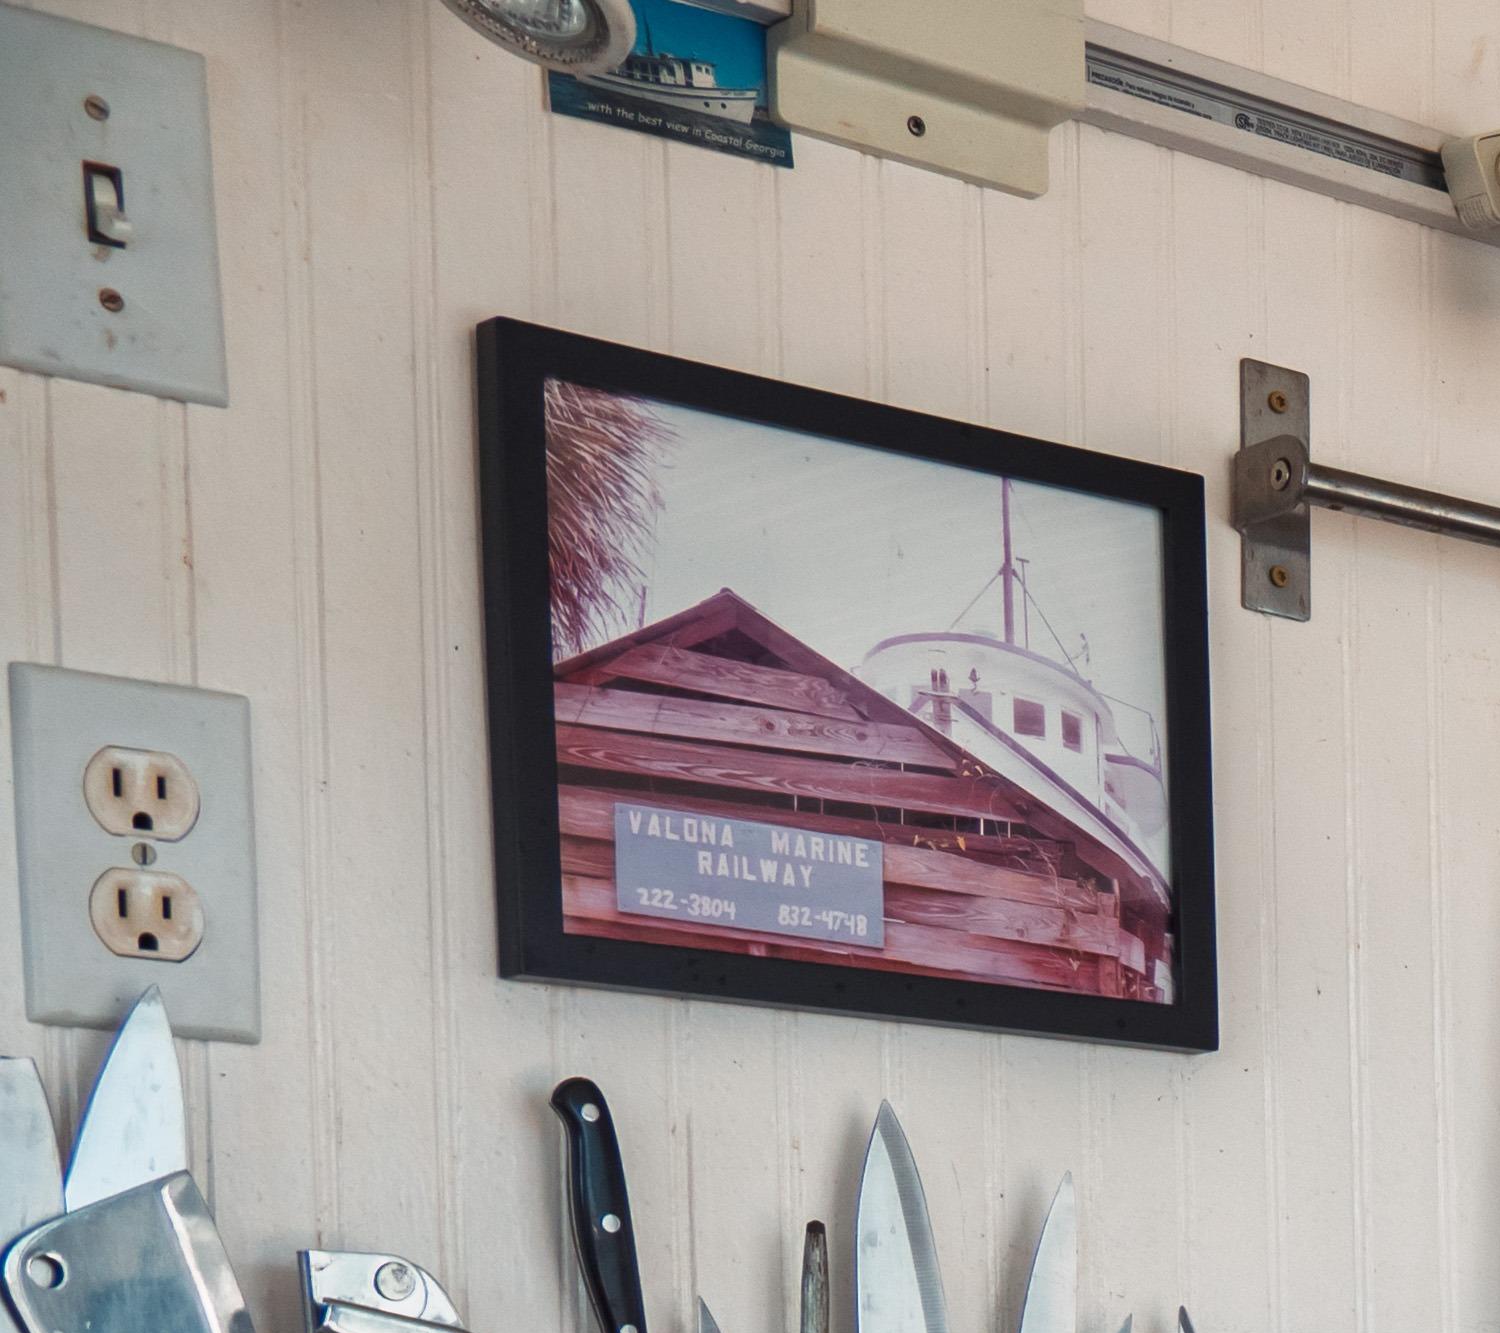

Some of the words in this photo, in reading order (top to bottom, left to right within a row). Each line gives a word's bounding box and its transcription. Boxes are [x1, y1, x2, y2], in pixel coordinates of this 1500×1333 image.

[617, 103, 635, 120] the
[637, 110, 663, 127] best
[665, 119, 689, 133] view
[692, 126, 702, 136] in
[704, 129, 743, 148] Coastal
[745, 139, 786, 159] Georgia
[628, 810, 734, 848] VALONA
[771, 830, 869, 867] MARINE
[697, 851, 814, 888] RAILWAY
[636, 887, 736, 920] 222-3804
[777, 903, 868, 937] 832-4748
